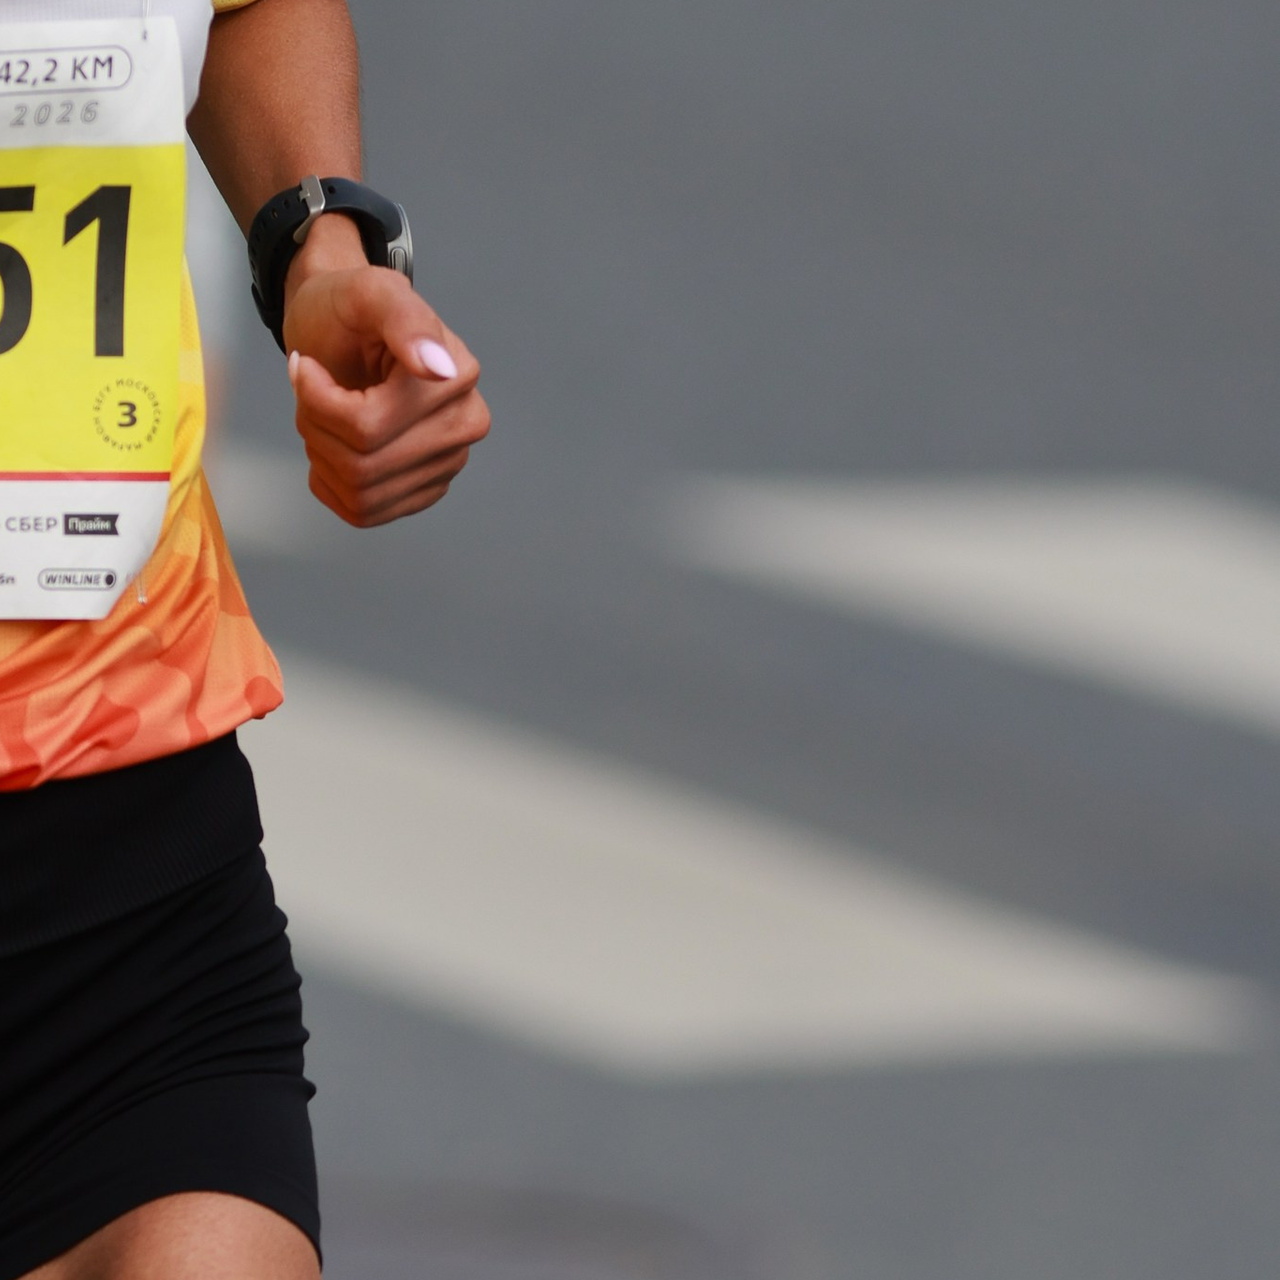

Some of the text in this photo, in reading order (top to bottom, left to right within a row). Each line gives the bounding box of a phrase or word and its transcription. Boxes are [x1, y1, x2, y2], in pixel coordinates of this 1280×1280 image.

[9, 99, 100, 128] 2026
[117, 400, 138, 428] 3
[5, 516, 112, 533] СБЕР Прайм
[45, 573, 102, 586] WINLINE
